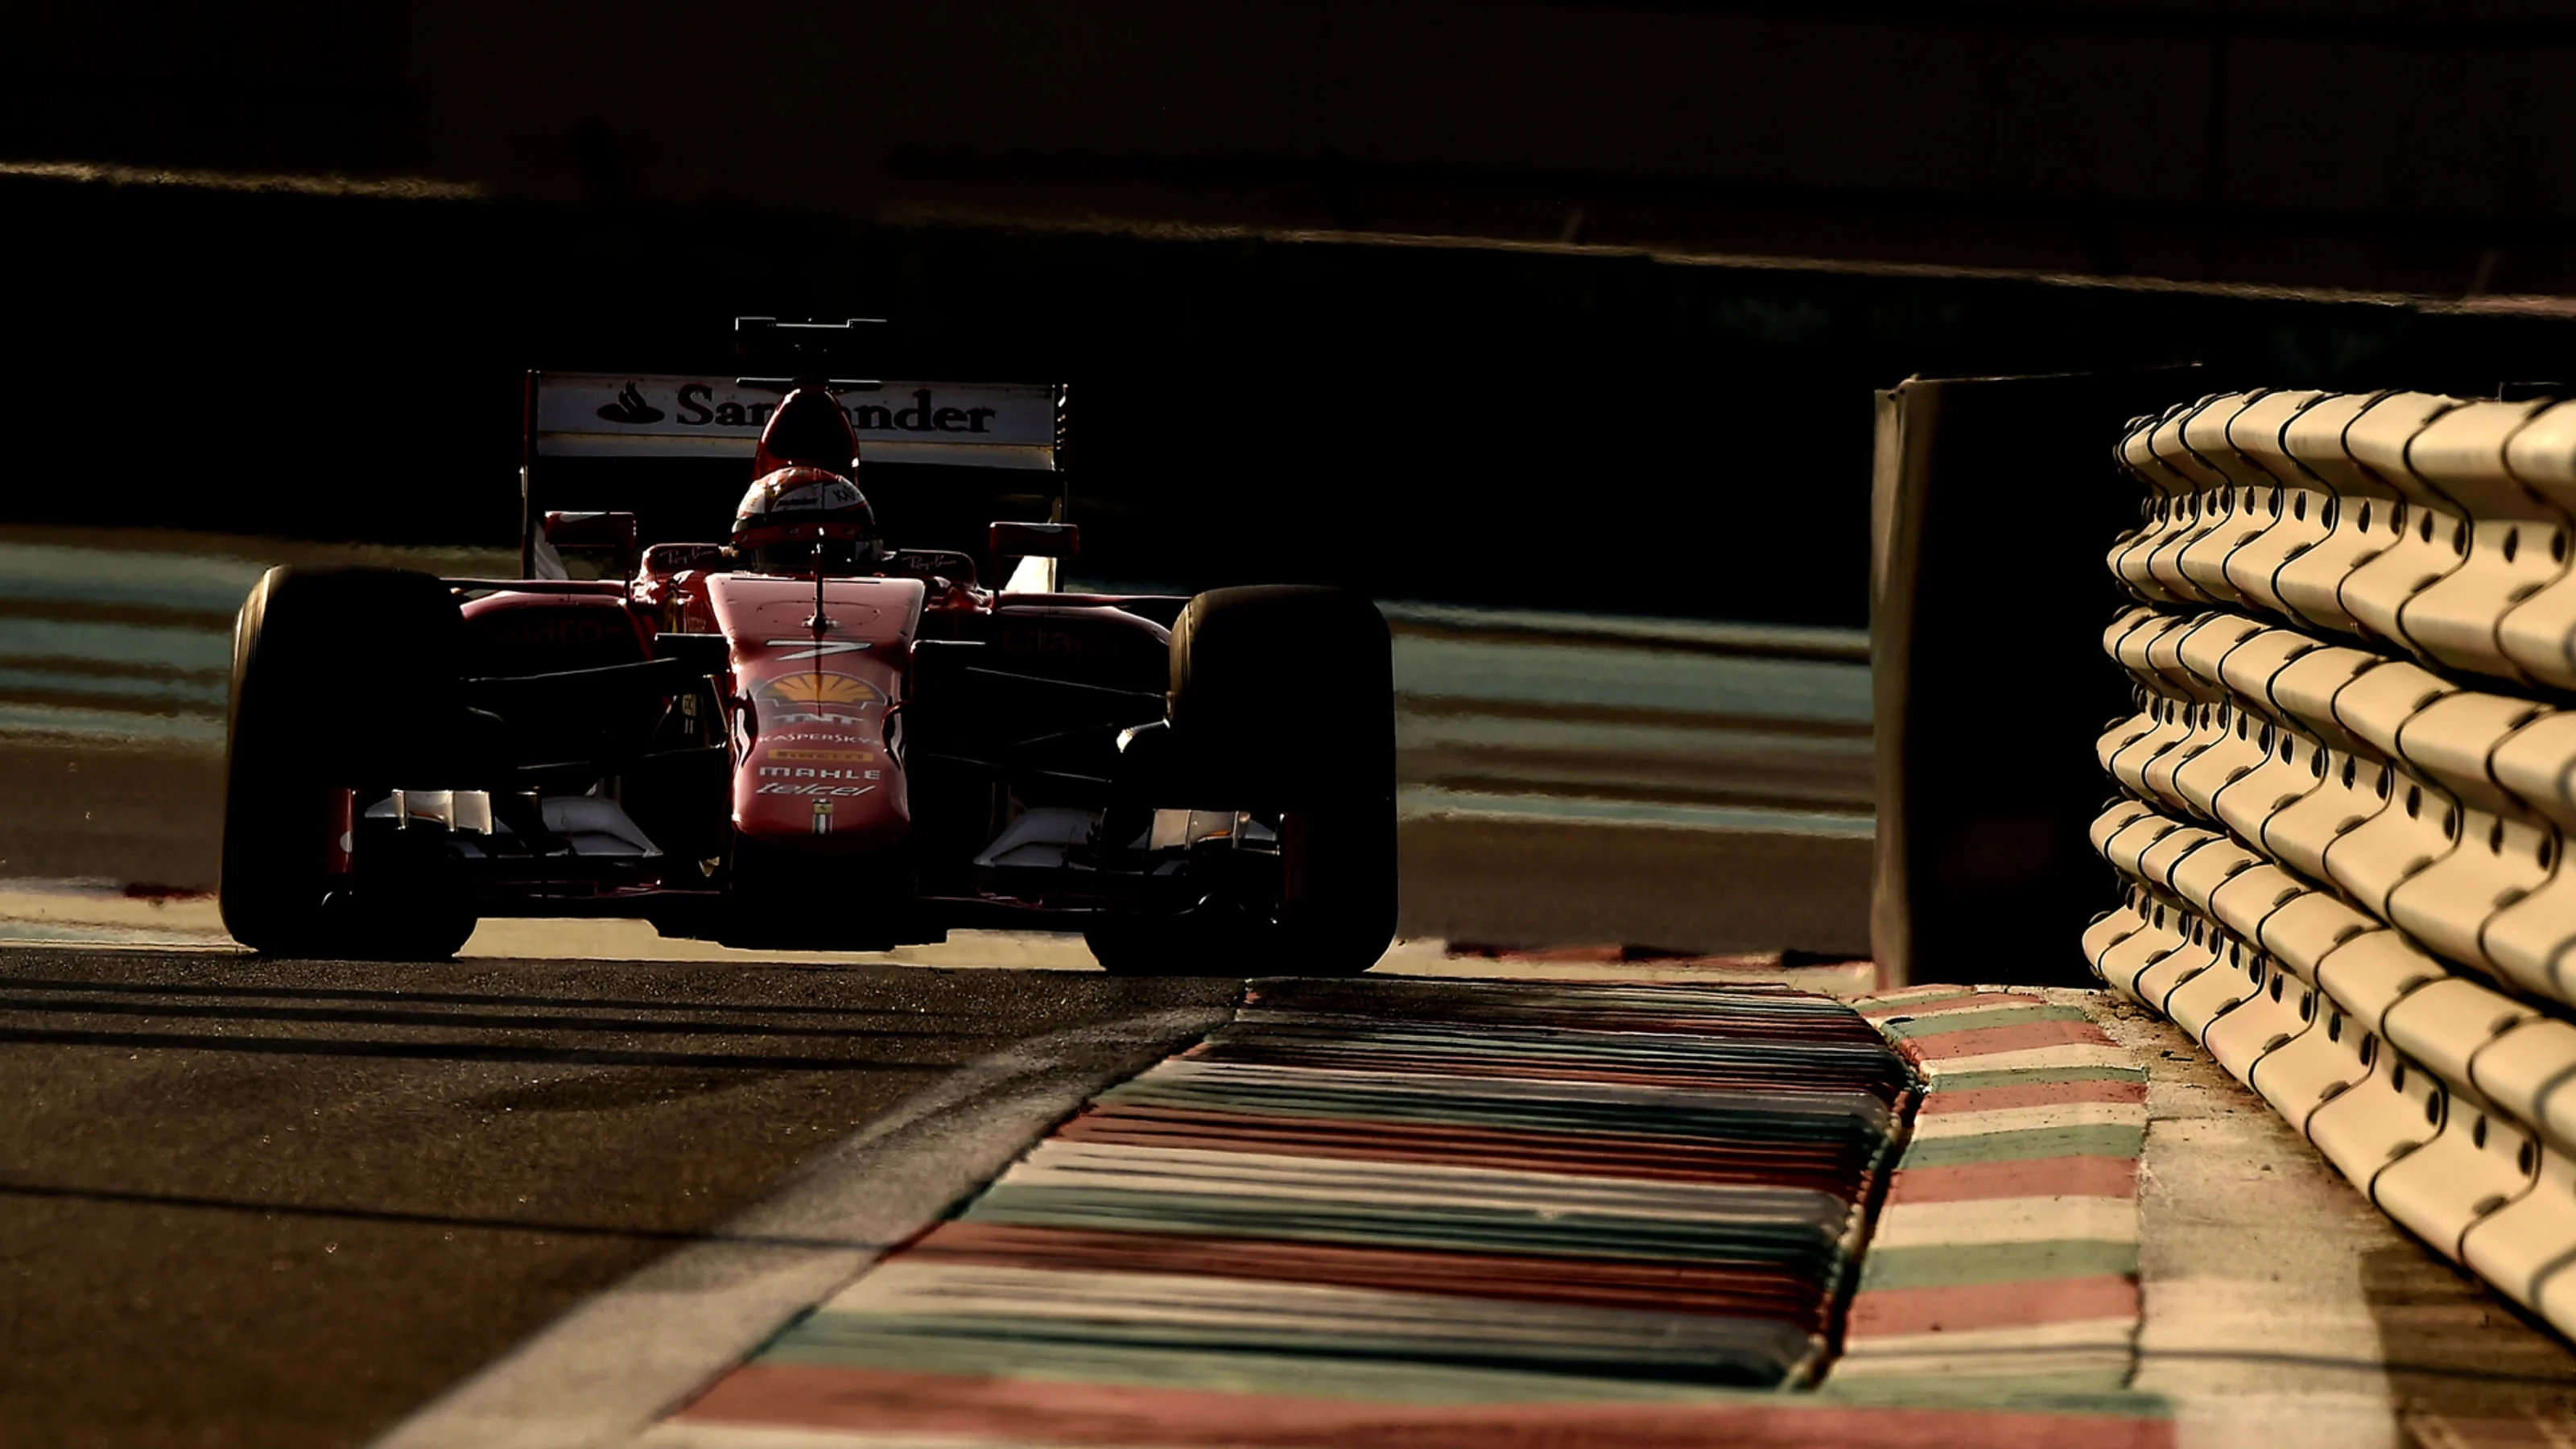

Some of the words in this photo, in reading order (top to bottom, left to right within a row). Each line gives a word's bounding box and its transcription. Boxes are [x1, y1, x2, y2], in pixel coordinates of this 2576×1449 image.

[765, 640, 872, 661] 7
[758, 733, 870, 743] KASPERSKY
[759, 766, 881, 780] MAHLE
[756, 782, 876, 797] telcel
